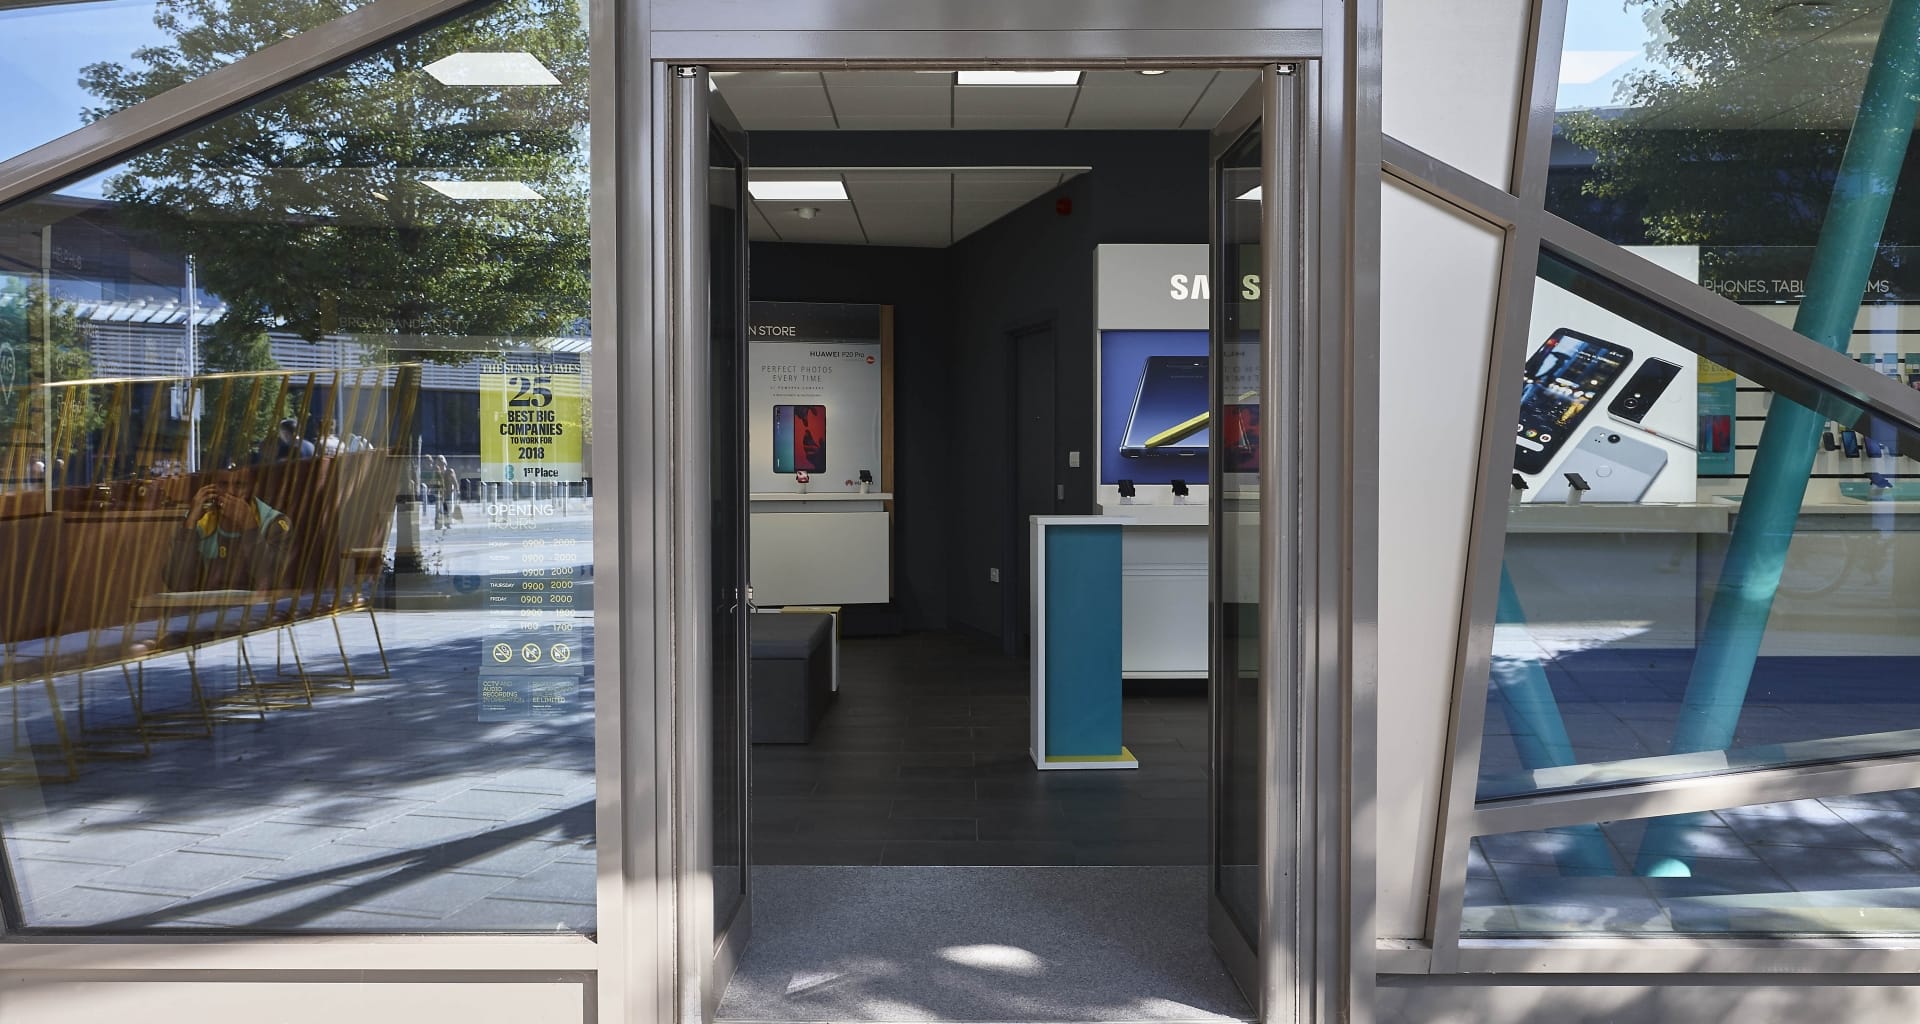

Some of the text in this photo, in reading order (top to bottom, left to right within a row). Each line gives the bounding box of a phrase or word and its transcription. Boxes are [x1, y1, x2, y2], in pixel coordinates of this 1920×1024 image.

[1704, 279, 1769, 294] PHONES,
[1864, 280, 1890, 293] MS
[758, 325, 797, 337] STORE
[483, 363, 503, 373] THE
[761, 365, 833, 374] PERFECT PHOTOS
[772, 374, 822, 383] EVERY TIME
[508, 376, 553, 408] 25
[508, 410, 555, 422] BEST BIG
[499, 423, 563, 436] COMPANIES
[518, 447, 545, 460] 2018
[535, 467, 559, 477] Place
[488, 504, 554, 516] OPENING
[488, 518, 537, 530] HOURS
[522, 568, 545, 577] 0900
[551, 566, 574, 576] 2000
[522, 582, 545, 591] 0900
[550, 580, 574, 589] 2000
[520, 595, 543, 604] 0900
[550, 594, 573, 603] 2000
[553, 623, 573, 632] 1700
